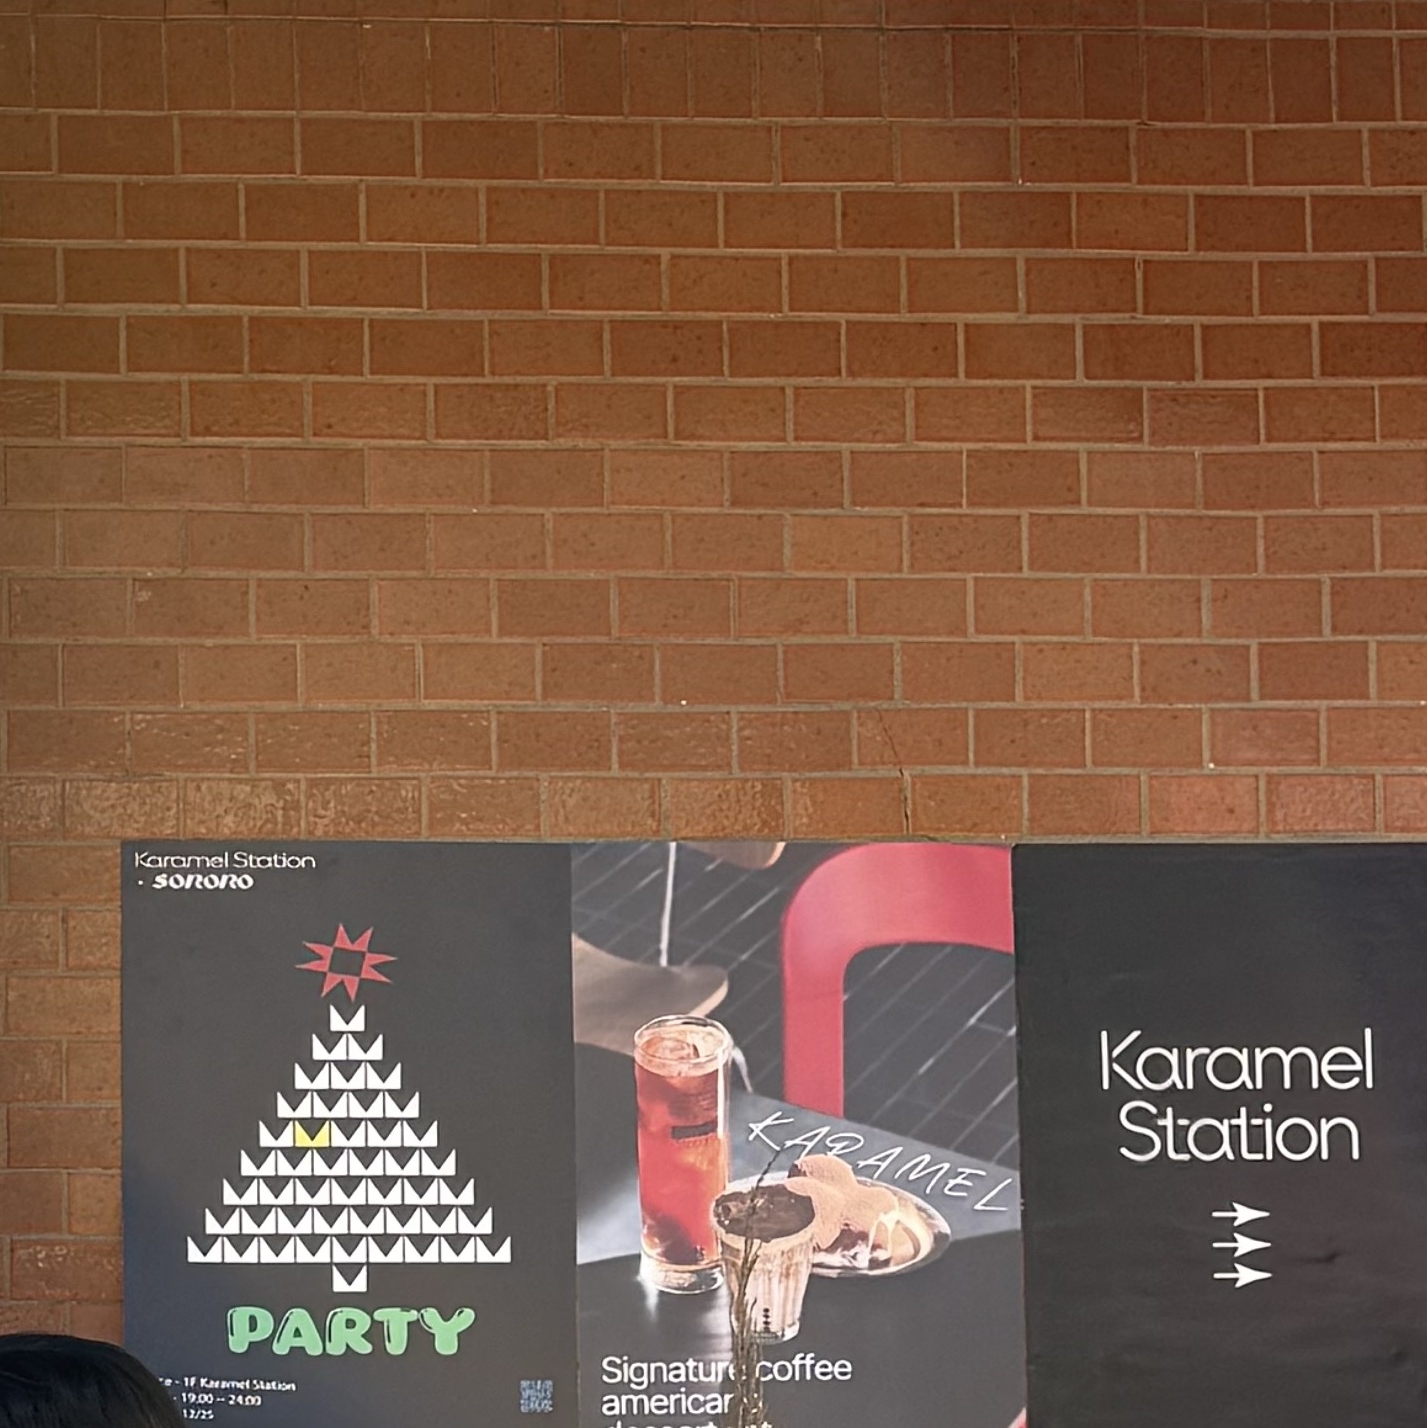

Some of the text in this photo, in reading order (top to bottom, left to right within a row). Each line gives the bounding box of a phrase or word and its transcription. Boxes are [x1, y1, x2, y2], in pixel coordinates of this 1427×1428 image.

[134, 851, 316, 869] Karamel Station
[1100, 1027, 1373, 1091] Karamel
[1119, 1100, 1360, 1162] Station
[227, 1306, 476, 1356] PARTY
[757, 1352, 853, 1382] coffee
